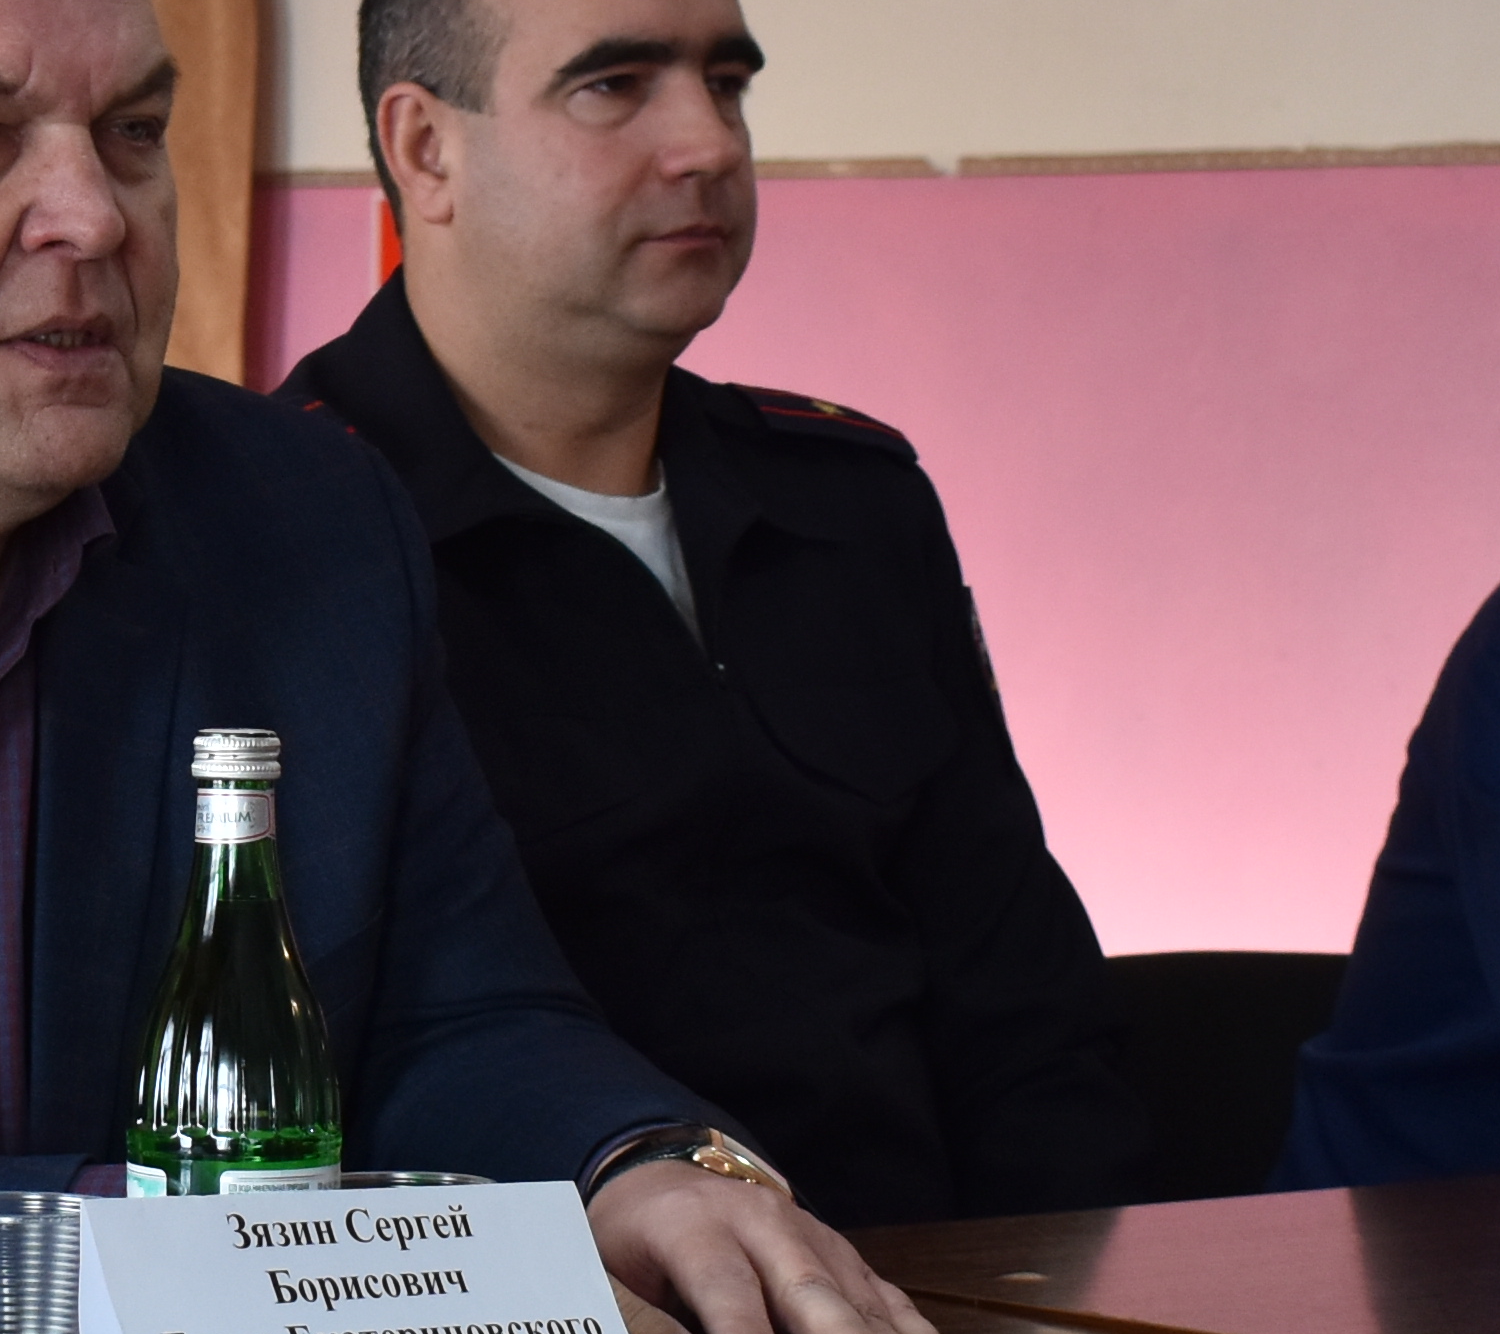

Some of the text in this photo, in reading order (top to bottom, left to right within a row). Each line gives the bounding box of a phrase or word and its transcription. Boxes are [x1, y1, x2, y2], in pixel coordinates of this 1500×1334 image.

[225, 1204, 474, 1250] Зязин Сергей
[268, 1269, 470, 1311] Борисович
